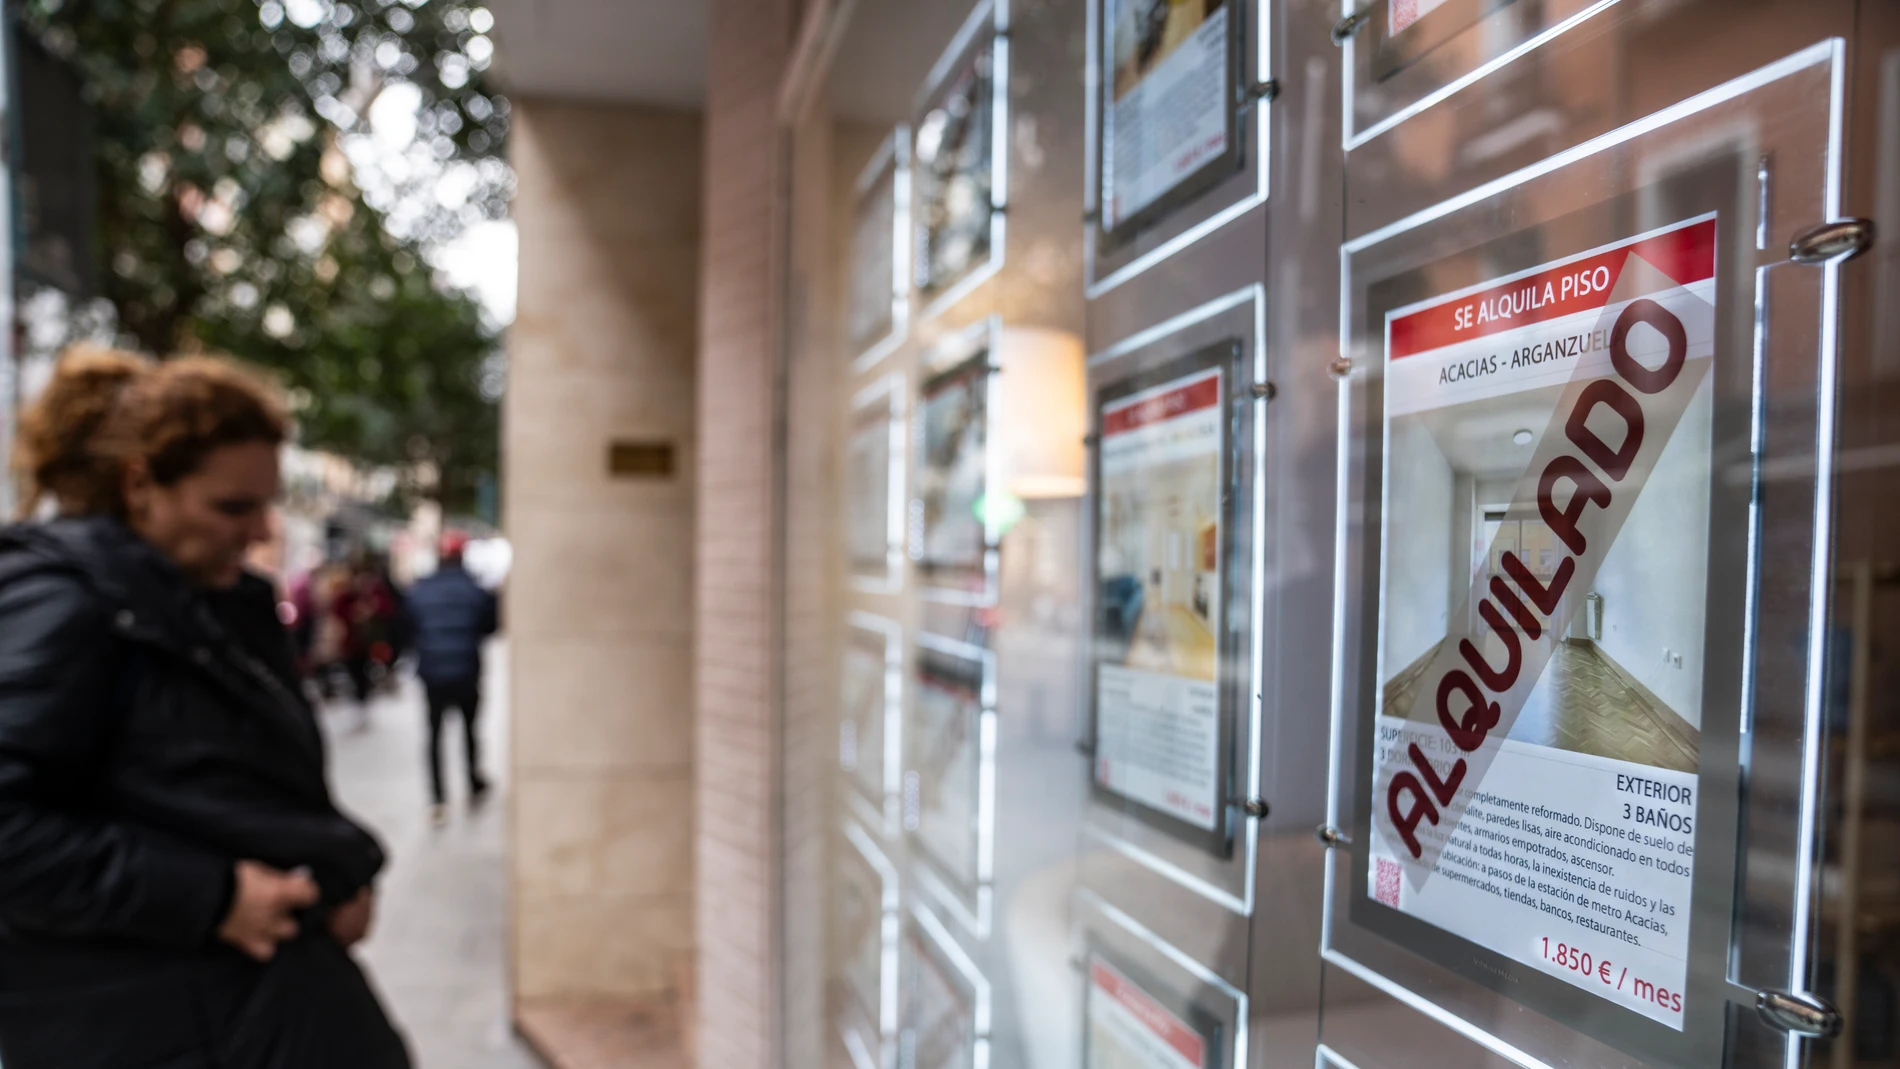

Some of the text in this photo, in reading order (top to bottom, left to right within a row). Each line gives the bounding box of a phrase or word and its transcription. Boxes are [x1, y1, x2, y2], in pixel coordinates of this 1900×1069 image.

[1454, 266, 1609, 331] SE ALQUILA PISO
[1439, 355, 1497, 385] ACACIAS
[1387, 298, 1687, 858] ALQUILADO
[1465, 789, 1529, 814] completamente
[1532, 805, 1582, 827] reformado.
[1584, 817, 1625, 839] Dispone
[1628, 829, 1641, 843] de
[1644, 835, 1674, 852] suelo
[1677, 841, 1693, 856] de
[1616, 774, 1691, 806] EXTERIOR
[1622, 803, 1692, 834] 3 BAÑOS
[1437, 815, 1473, 835] bientes,
[1474, 827, 1510, 845] armarios
[1512, 837, 1569, 864] empotrados,
[1571, 855, 1615, 876] ascensor.
[1445, 835, 1472, 850] natural
[1473, 845, 1478, 853] a
[1480, 845, 1502, 861] todas
[1504, 850, 1531, 870] horas,
[1532, 859, 1540, 872] la
[1542, 863, 1596, 891] inexistencia
[1598, 881, 1612, 895] de
[1614, 888, 1647, 907] ruidos
[1649, 899, 1657, 912] y
[1659, 899, 1675, 916] las
[1486, 812, 1520, 830] paredes
[1522, 819, 1543, 837] lisas,
[1545, 827, 1562, 841] aire
[1564, 833, 1636, 862] acondicionado
[1638, 855, 1653, 867] en
[1656, 858, 1690, 878] todos
[1442, 850, 1480, 870] ubicación:
[1481, 864, 1486, 873] a
[1488, 867, 1512, 881] pasos
[1514, 873, 1526, 886] de
[1528, 876, 1536, 889] la
[1537, 882, 1575, 903] estación
[1577, 894, 1590, 908] de
[1591, 901, 1622, 919] metro
[1624, 910, 1668, 936] Acacias,
[1442, 867, 1502, 897] supermercados,
[1504, 888, 1538, 910] tiendas,
[1540, 899, 1574, 923] bancos,
[1576, 914, 1642, 946] restaurantes.
[1542, 937, 1682, 1013] 1.850 € / mes
